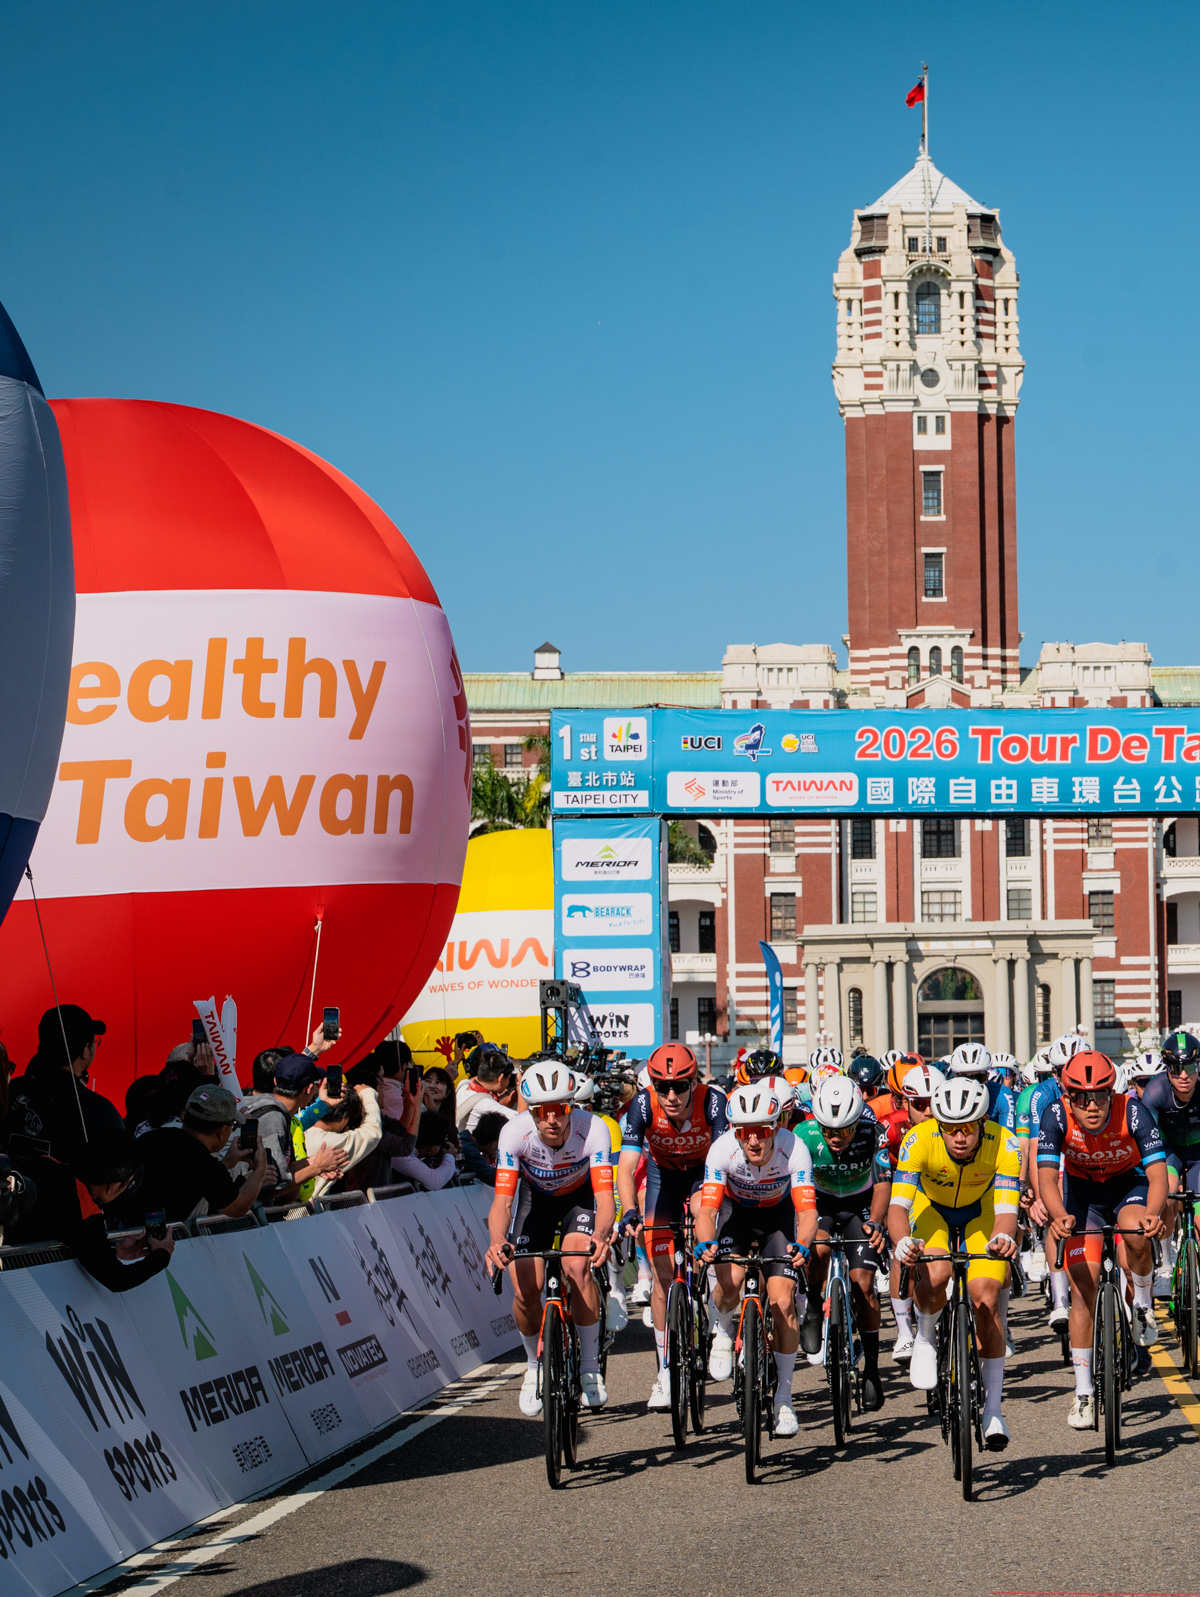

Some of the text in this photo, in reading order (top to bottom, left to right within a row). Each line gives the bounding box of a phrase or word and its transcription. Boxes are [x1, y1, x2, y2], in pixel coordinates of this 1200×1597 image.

[558, 724, 598, 761] 1 st
[579, 733, 598, 743] STAGE
[690, 736, 722, 750] UCI
[855, 727, 959, 760] 2026
[970, 727, 1079, 763] Tour
[1086, 726, 1149, 762] De
[608, 744, 643, 753] TAIPEI
[567, 771, 636, 788] 臺北市站
[712, 779, 739, 788] 運動部
[771, 779, 853, 792] TAIWAN
[58, 751, 415, 845] Taiwan
[564, 794, 639, 805] TAIPEI CITY
[712, 788, 736, 797] Ministry
[575, 860, 639, 868] MERIDA
[595, 907, 631, 917] BEARACK
[435, 937, 554, 973] IWA
[592, 964, 646, 972] BODYWRAP
[428, 981, 464, 994] WAVES
[468, 980, 484, 990] OF
[590, 1030, 629, 1038] SPORTS
[204, 1010, 232, 1076] TAIWAN
[1003, 1092, 1015, 1128] GIANT
[904, 1132, 919, 1149] AOT
[308, 1256, 341, 1304] N
[340, 1338, 385, 1374] NOVATEC
[267, 1341, 335, 1397] MERIDA
[179, 1365, 270, 1432] MERIDA
[104, 1431, 178, 1502] SPORTS
